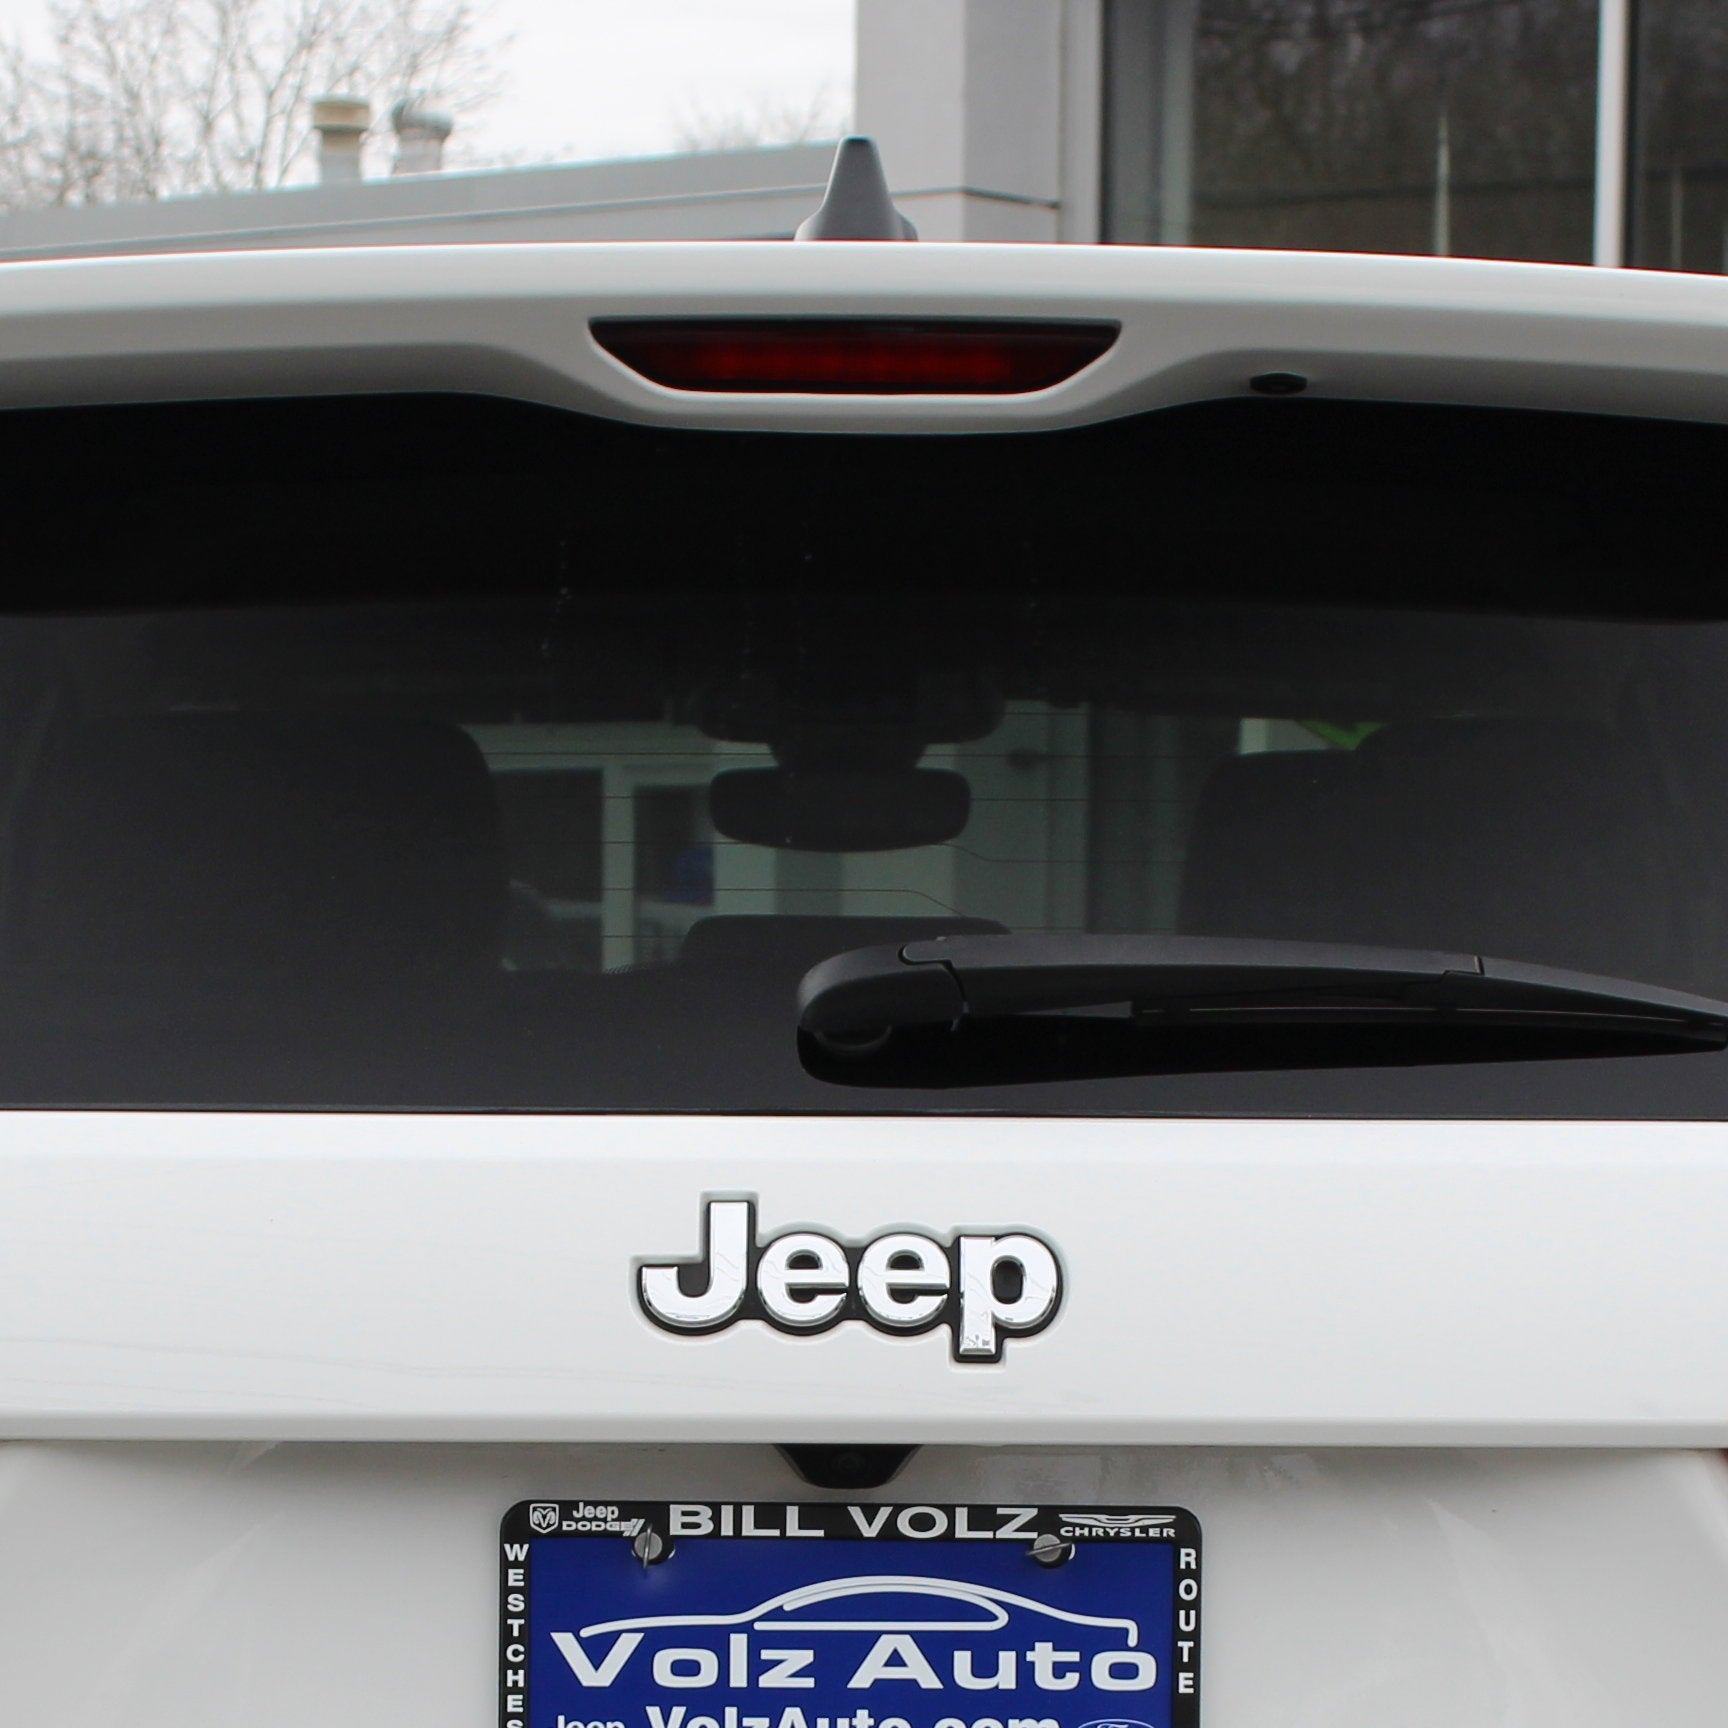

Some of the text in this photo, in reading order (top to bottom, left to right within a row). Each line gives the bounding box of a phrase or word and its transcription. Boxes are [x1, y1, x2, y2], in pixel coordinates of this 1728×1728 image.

[638, 1199, 1063, 1361] Jeep
[562, 1520, 632, 1532] DODGE
[572, 1502, 619, 1521] Jeep
[669, 1504, 1039, 1540] BILL VOLZ
[1060, 1526, 1176, 1538] CHRYSLER
[1177, 1547, 1198, 1695] ROUTE
[550, 1632, 1158, 1691] Volz Auto
